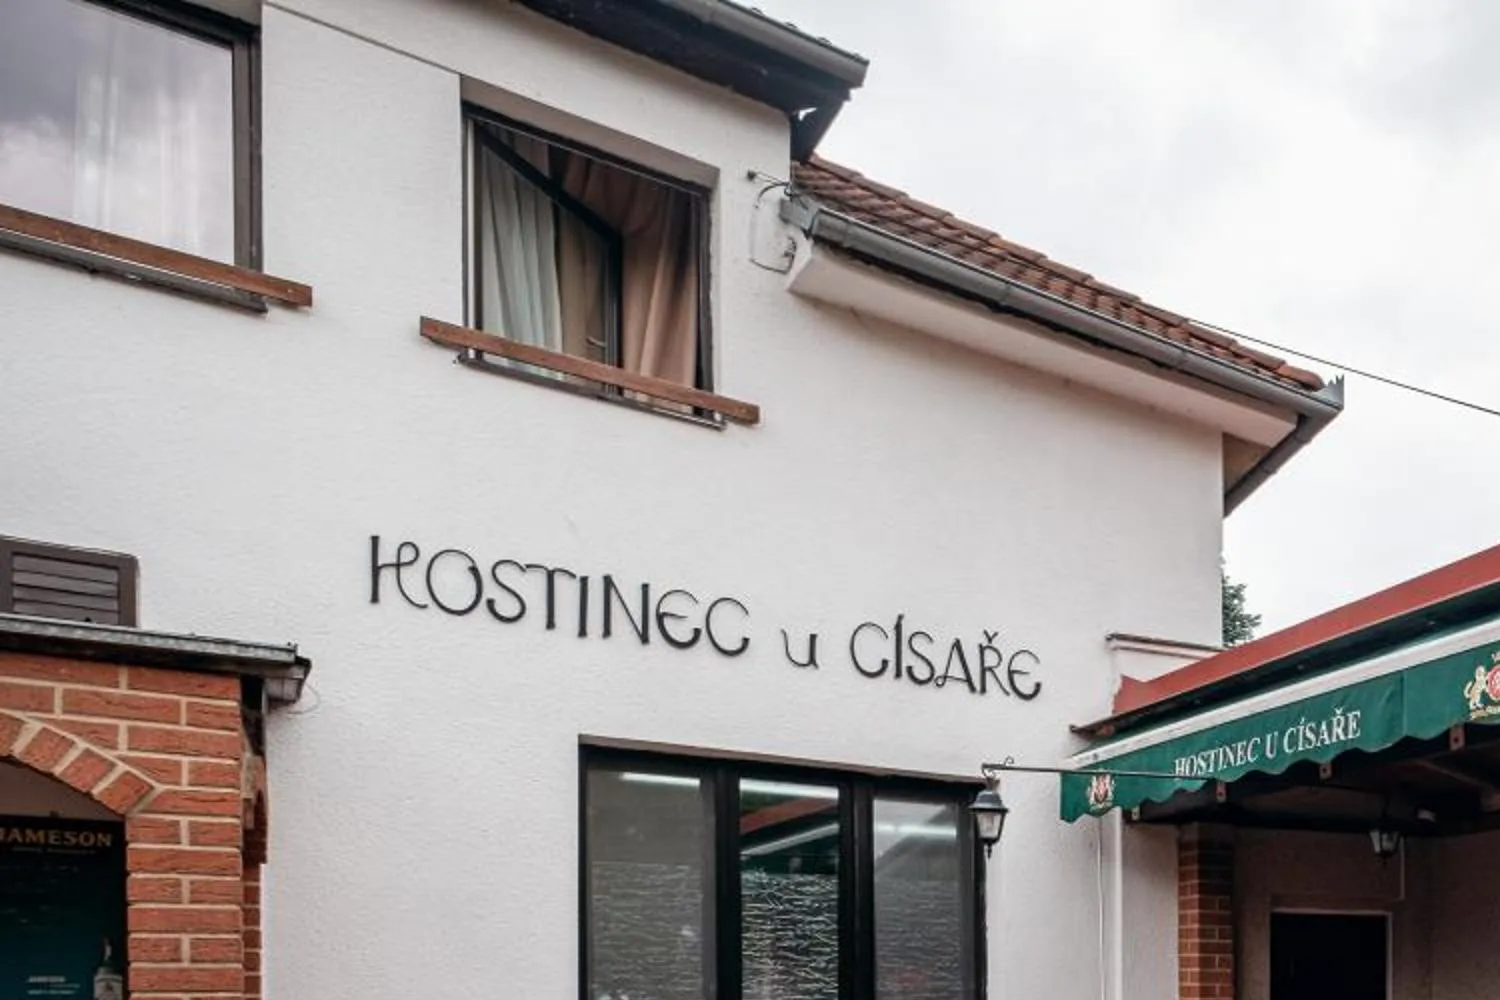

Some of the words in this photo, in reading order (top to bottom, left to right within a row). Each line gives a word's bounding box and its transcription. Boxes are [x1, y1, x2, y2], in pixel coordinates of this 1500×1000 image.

[369, 534, 751, 657] HOSTINEC
[1174, 737, 1261, 777] HOSTINEC
[1265, 730, 1279, 760] U
[1283, 706, 1362, 754] CÍSAŘE
